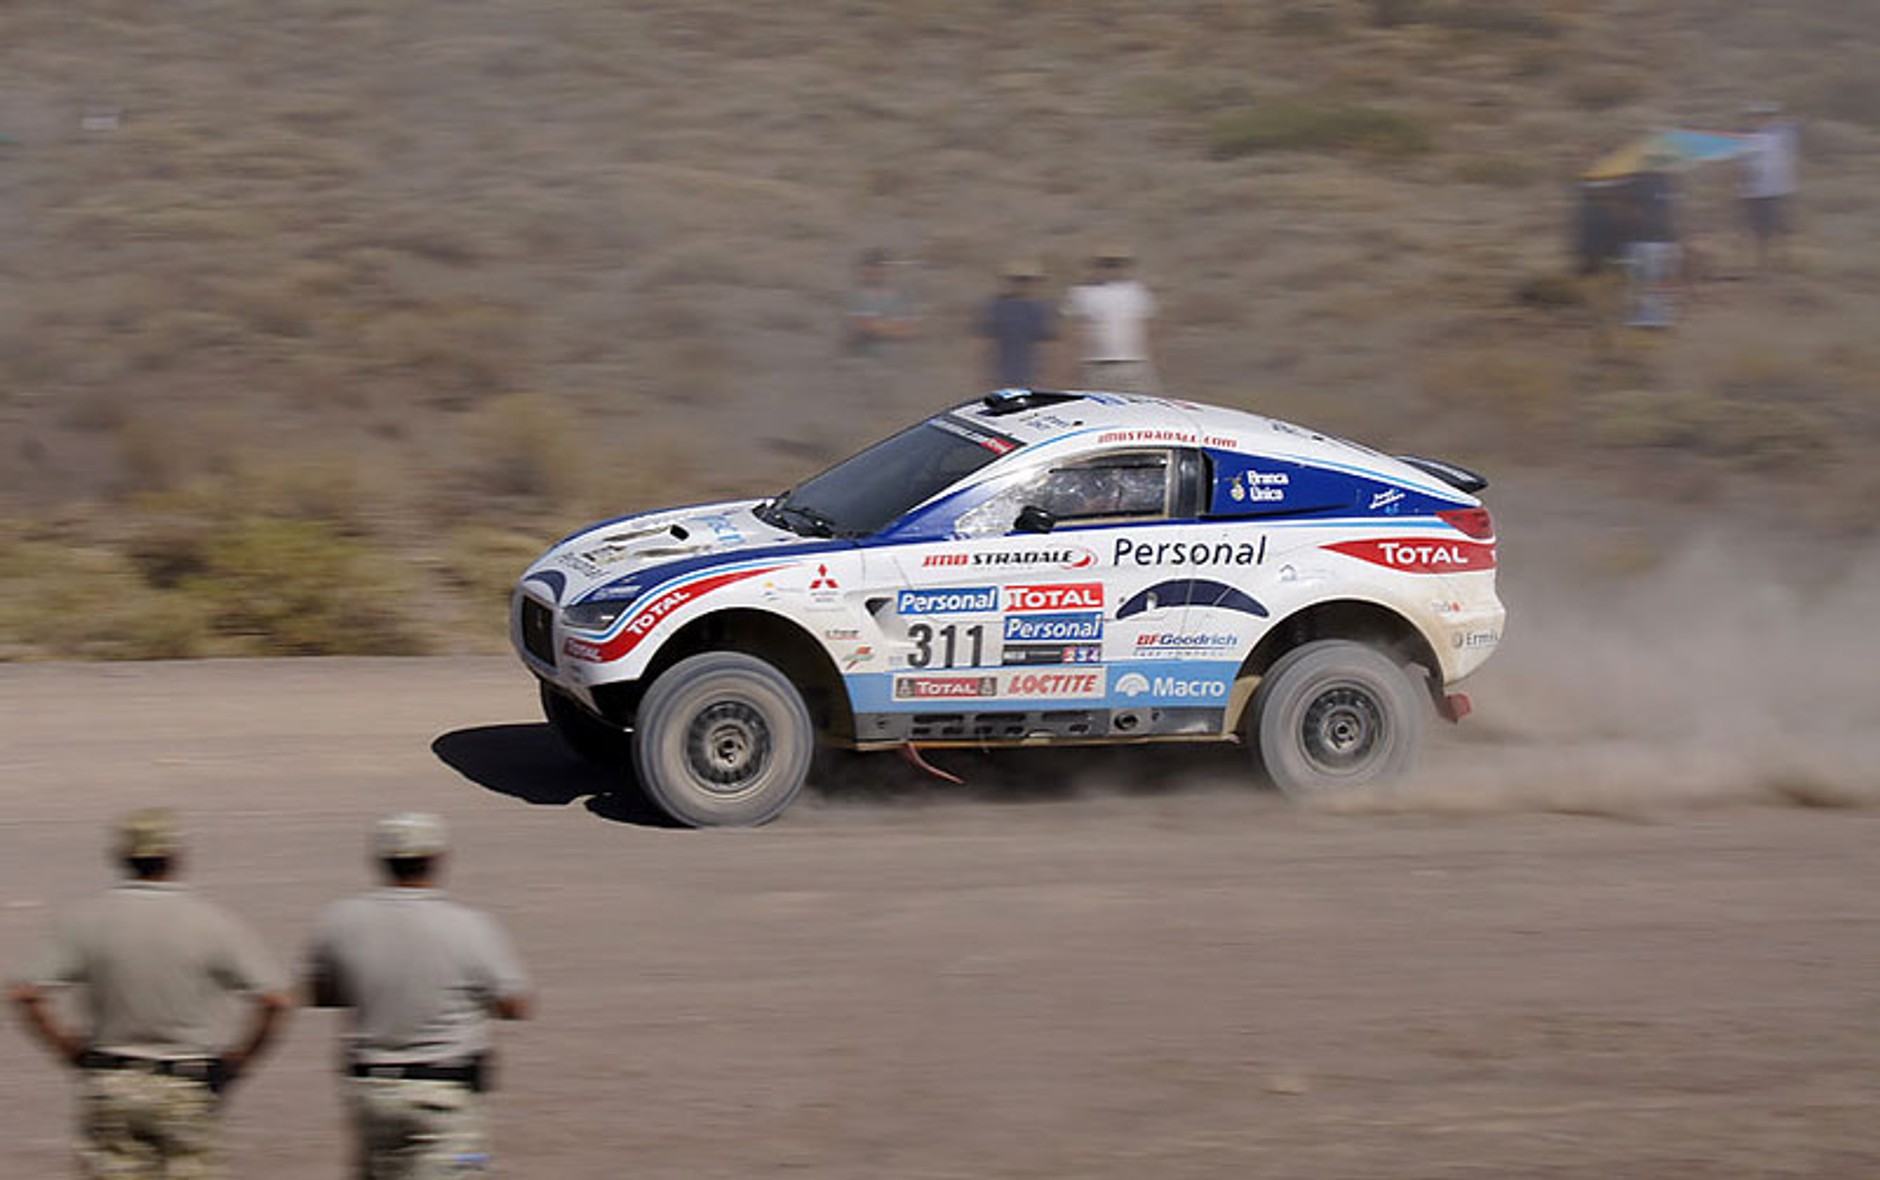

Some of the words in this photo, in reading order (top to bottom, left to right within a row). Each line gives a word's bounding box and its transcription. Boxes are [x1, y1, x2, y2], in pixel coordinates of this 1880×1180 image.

[972, 550, 1073, 565] STRADALE
[1114, 535, 1267, 566] Personal
[1378, 542, 1468, 564] TOTAL
[900, 587, 996, 612] Personal
[1006, 588, 1101, 610] TOTAL
[626, 592, 691, 634] TOTAL
[1006, 612, 1101, 638] Personal
[907, 623, 985, 668] 311
[1137, 634, 1237, 645] BFGoodrich
[916, 681, 977, 694] TOTAL
[1008, 675, 1097, 694] LOCTITE
[1153, 677, 1226, 697] Macro
